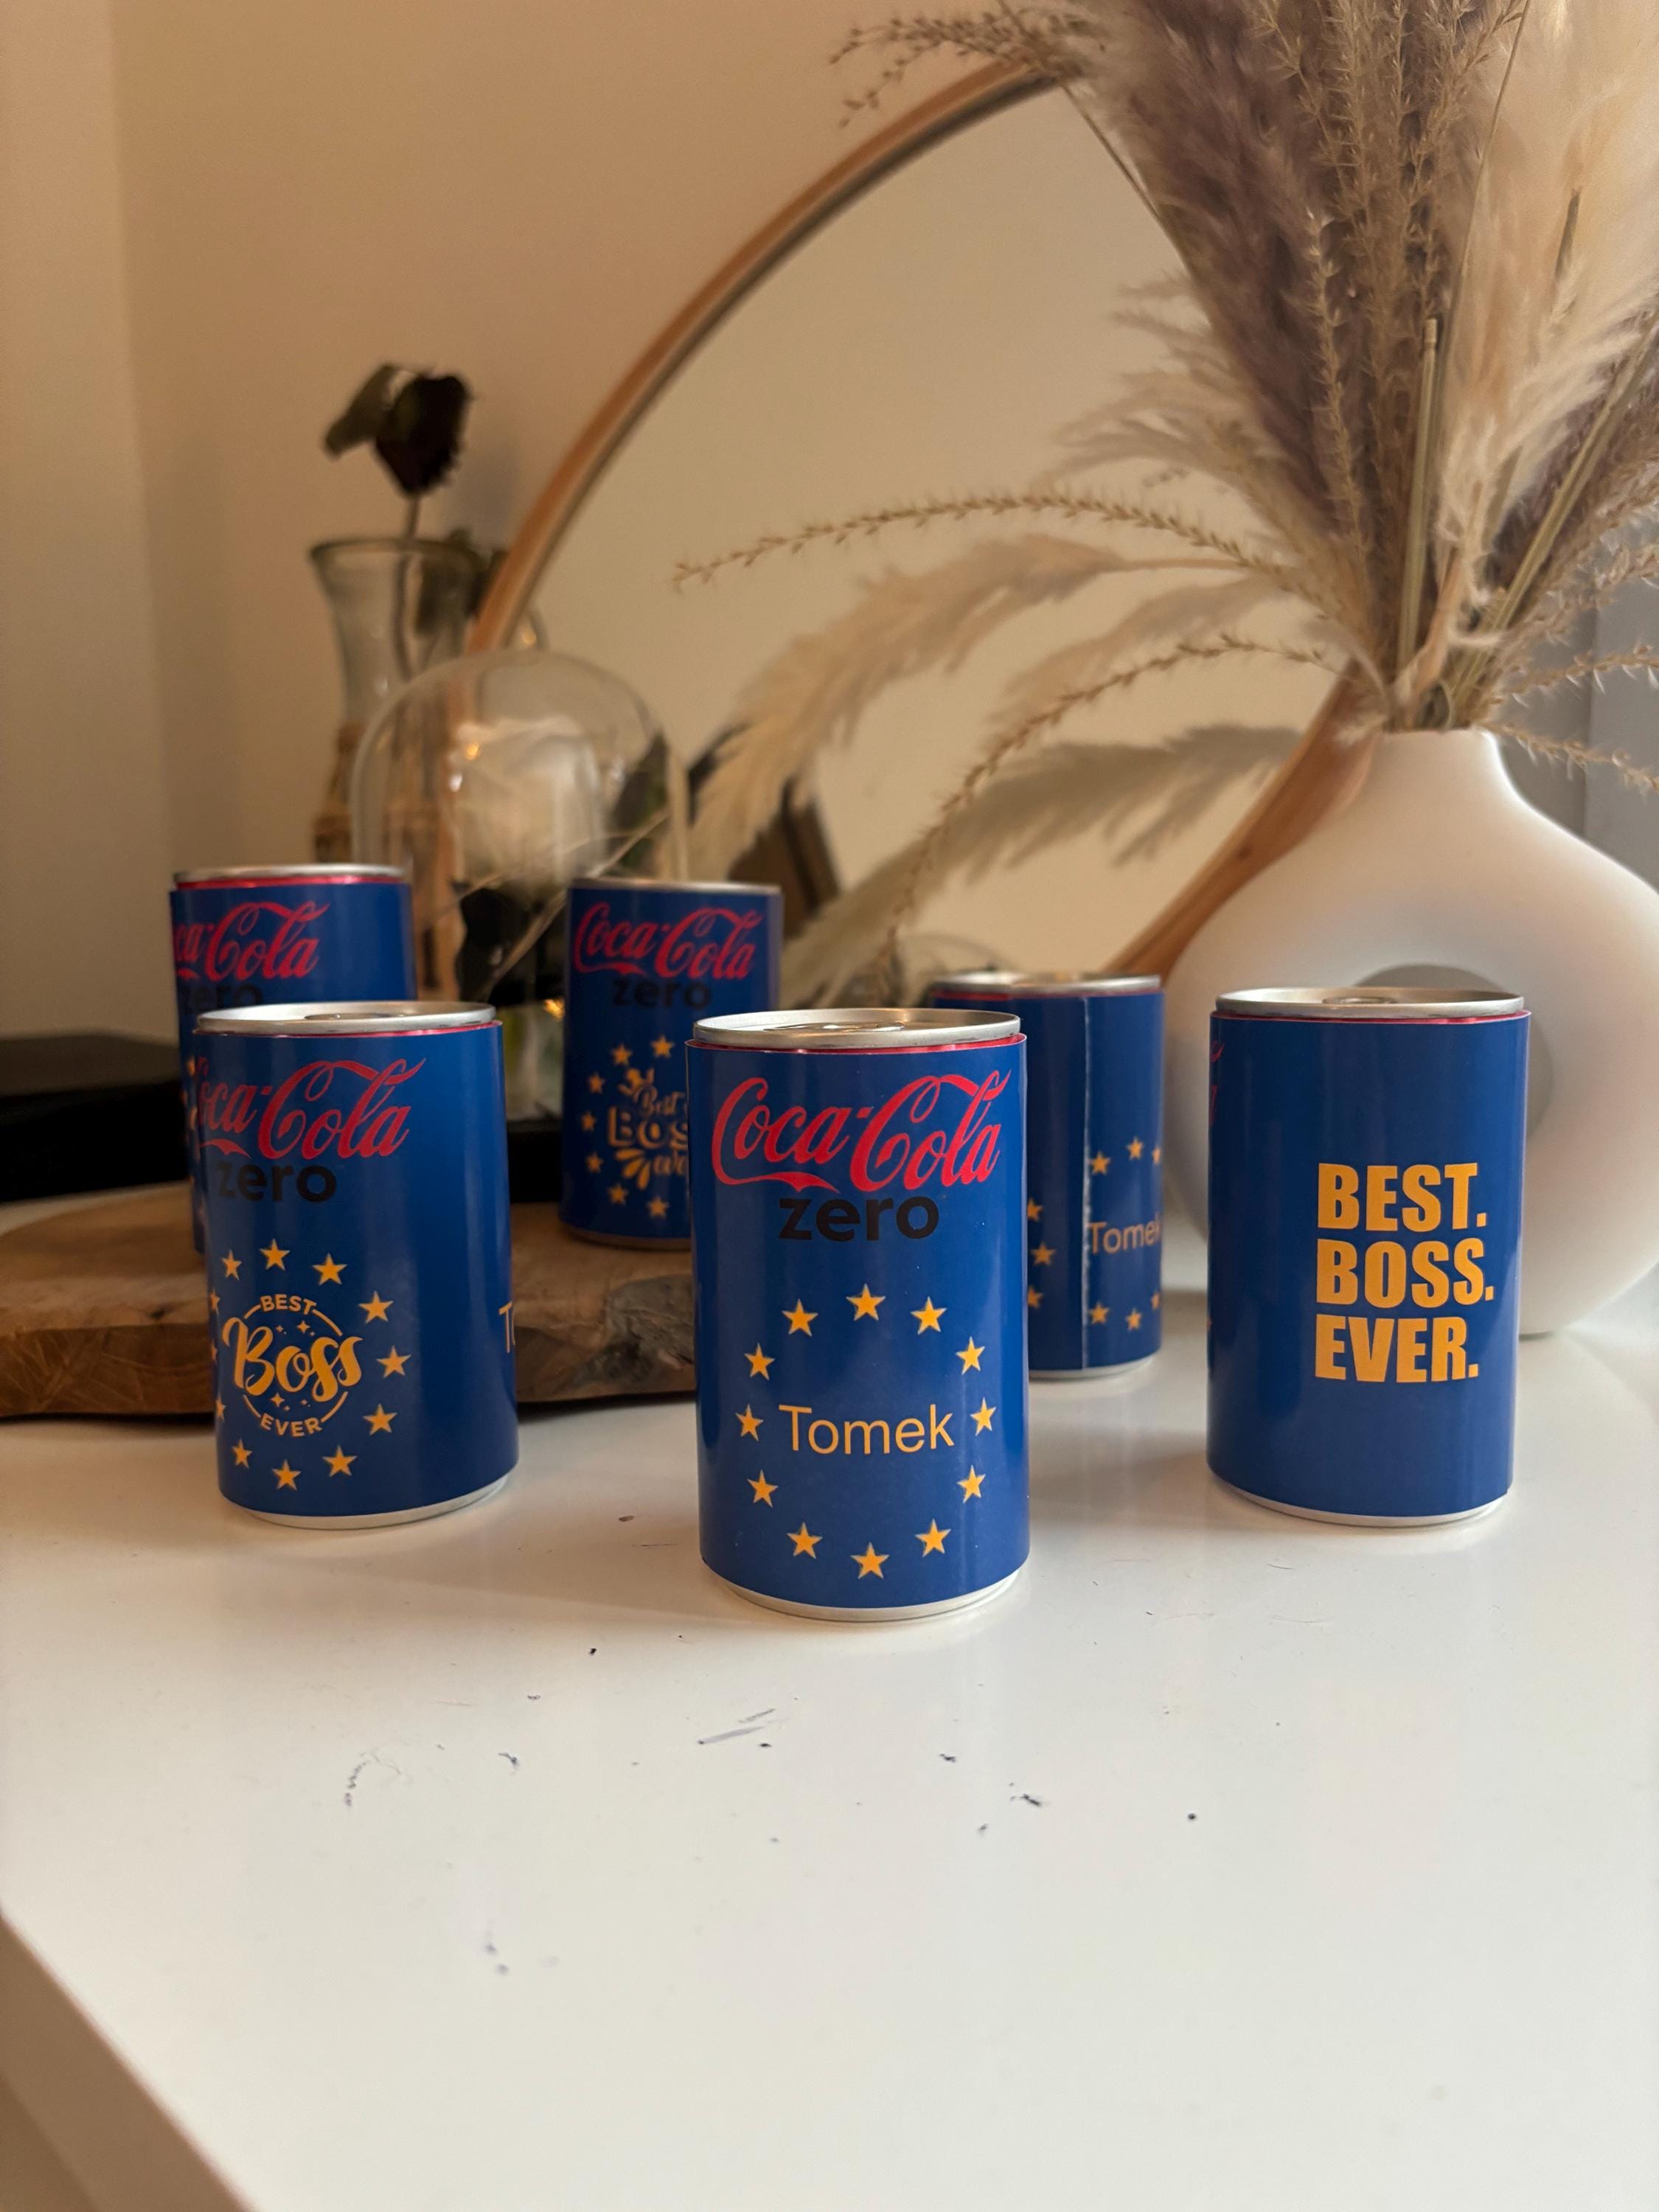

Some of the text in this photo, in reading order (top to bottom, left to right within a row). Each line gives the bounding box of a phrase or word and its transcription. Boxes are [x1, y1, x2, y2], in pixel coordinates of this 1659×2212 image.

[173, 900, 330, 982] ca-Cola
[574, 902, 762, 980] Coca-Cola
[613, 978, 711, 1009] zero
[197, 1057, 425, 1160] oca-Cola
[608, 1106, 688, 1150] BOS
[711, 1069, 1012, 1193] Coca-Cola
[215, 1162, 337, 1203] zero
[778, 1194, 939, 1242] zero
[1317, 1162, 1487, 1233] BEST.
[260, 1293, 317, 1314] BEST
[1316, 1237, 1495, 1310] BOSS.
[222, 1317, 364, 1402] Boss
[1315, 1313, 1479, 1384] EVER.
[260, 1416, 323, 1438] EVER
[779, 1403, 954, 1455] Tomek
